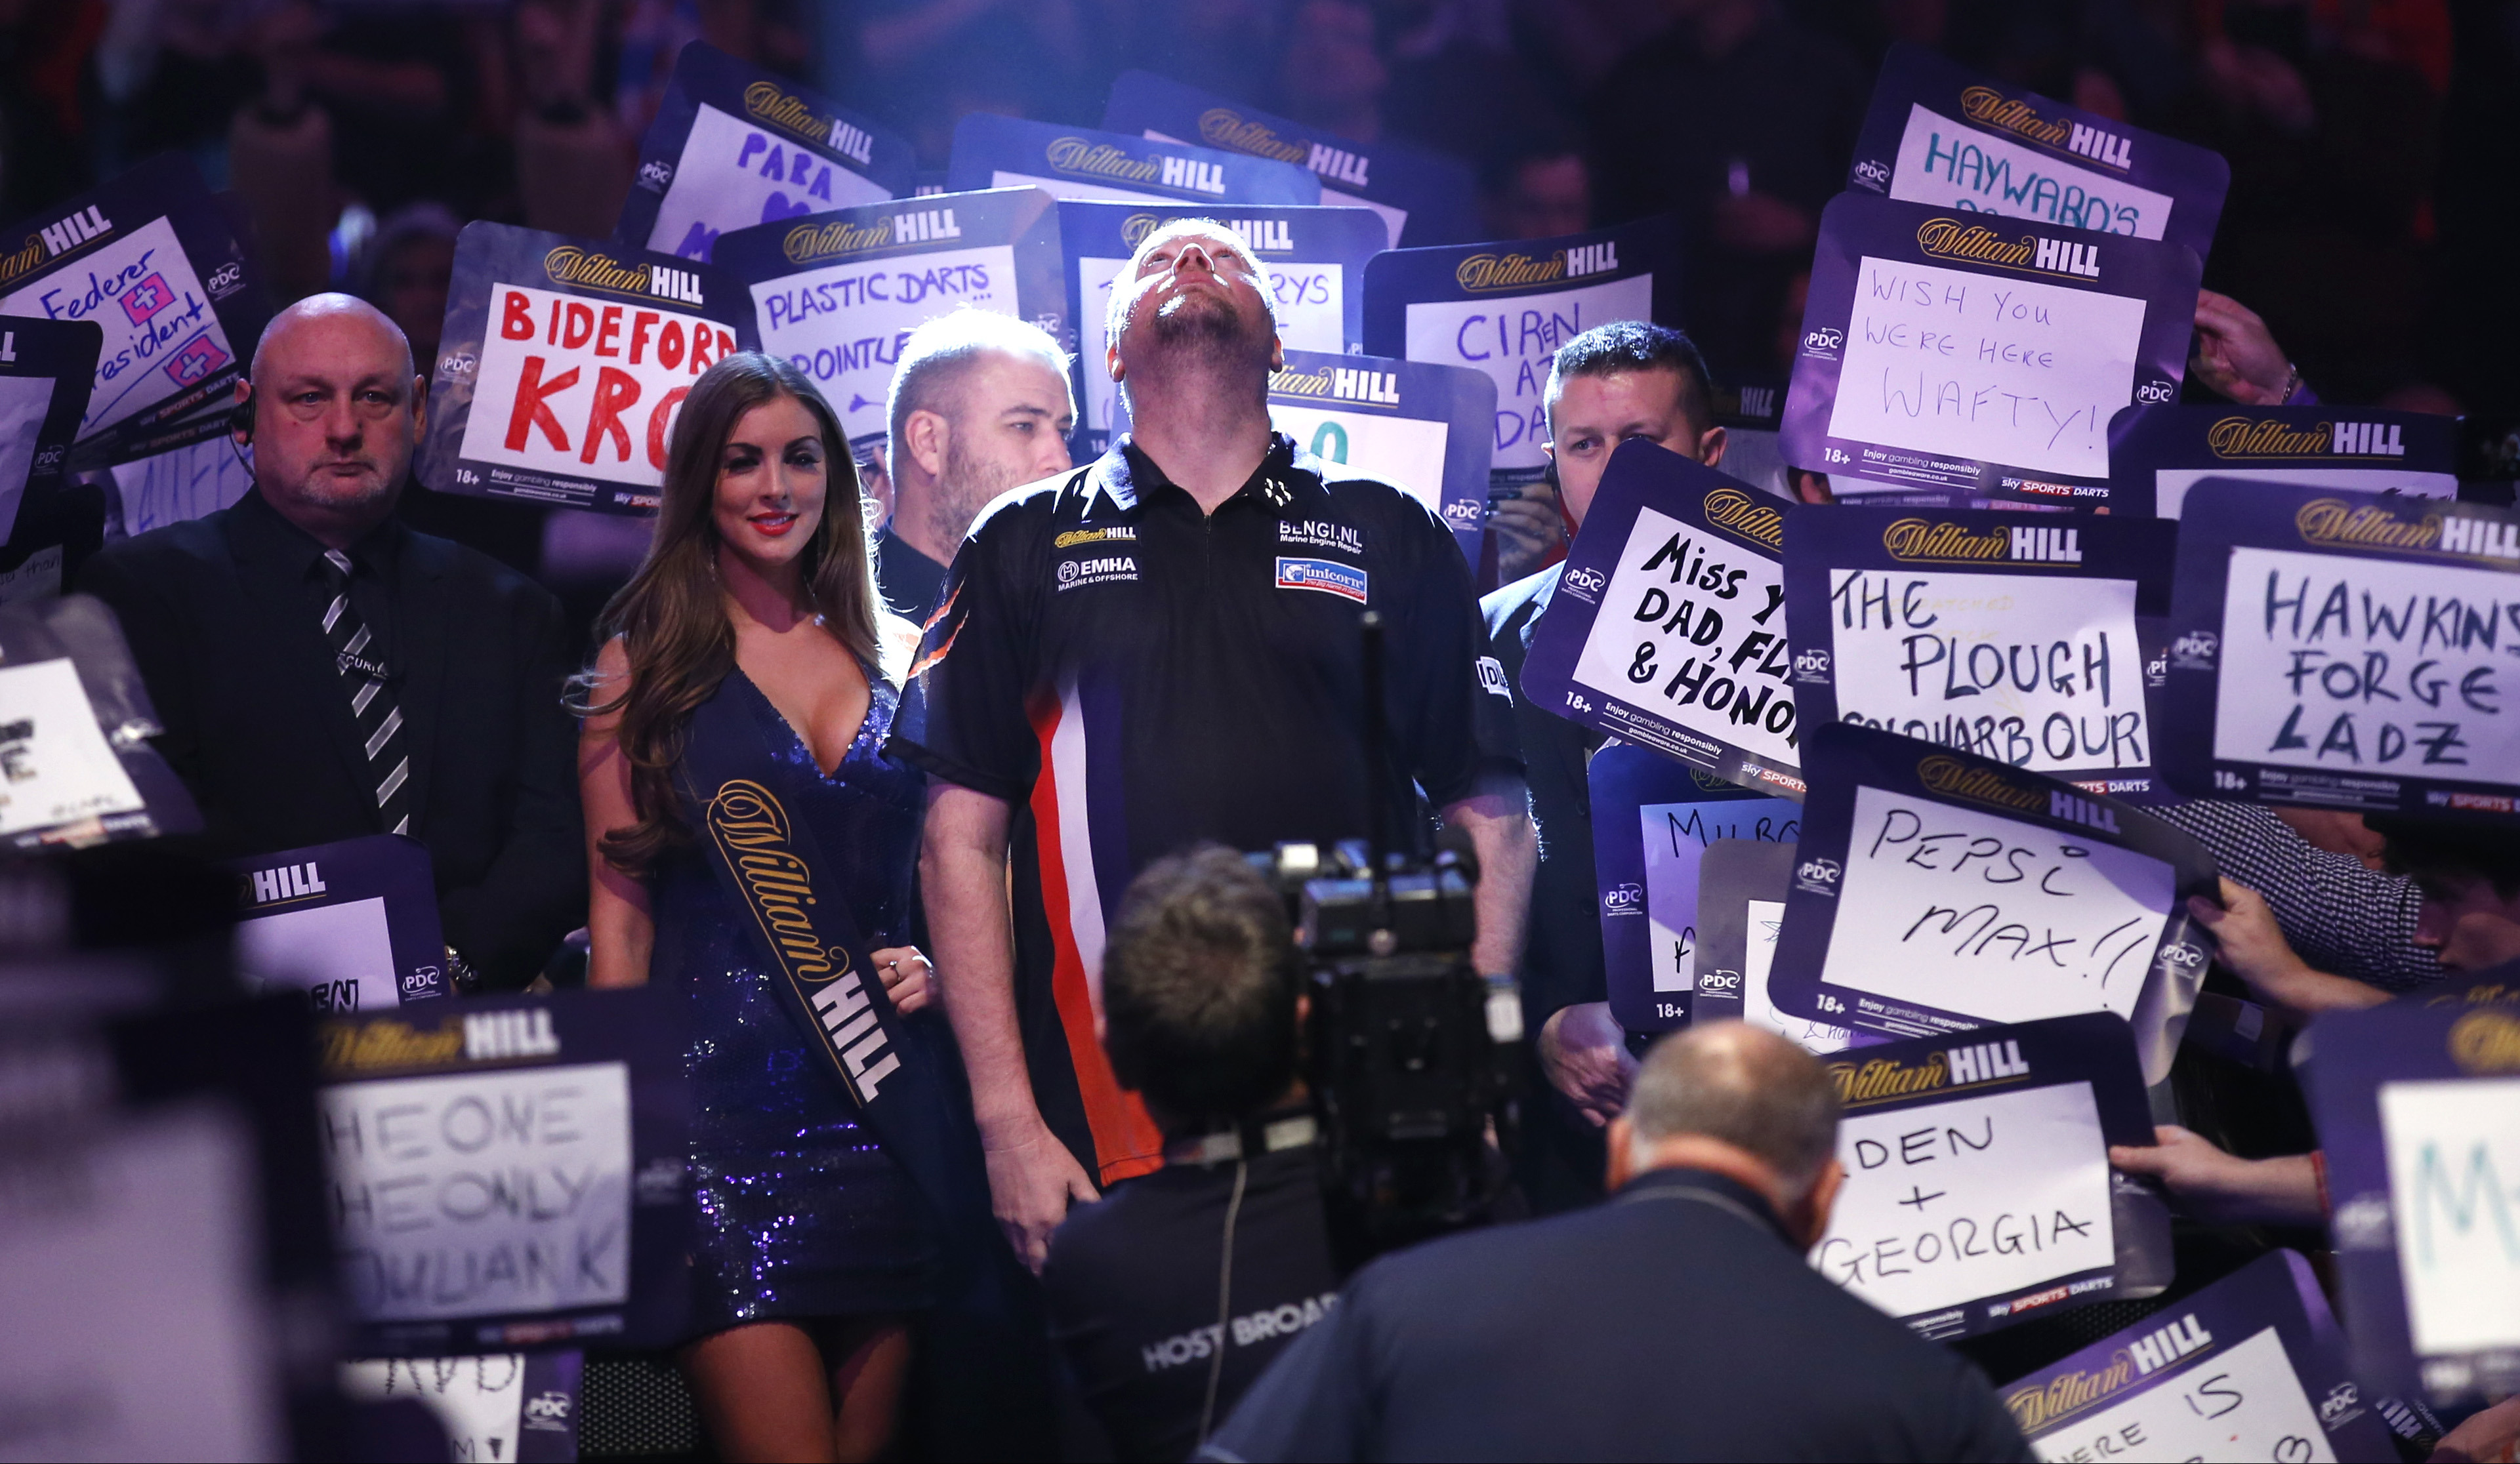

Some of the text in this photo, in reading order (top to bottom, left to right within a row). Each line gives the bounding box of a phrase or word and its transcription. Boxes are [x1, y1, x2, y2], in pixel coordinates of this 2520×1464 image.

[744, 81, 873, 165] William HILL
[1960, 86, 2132, 171] William HILL
[737, 132, 831, 202] PARA
[1046, 136, 1226, 195] William HILL
[1199, 108, 1369, 187] William HILL
[1856, 161, 1889, 183] PDC
[1924, 132, 2139, 237] HAYWARD'S
[41, 204, 112, 256] HILL
[783, 209, 960, 263] William HILL
[1231, 220, 1294, 250] HILL
[1917, 218, 2099, 277] William HILL
[39, 249, 155, 319] Federer
[208, 266, 240, 293] PDC
[544, 246, 703, 304] William HILL
[1456, 241, 1618, 293] William HILL
[766, 273, 888, 330] PLASTIC
[1873, 270, 1966, 314] WISH
[90, 292, 204, 392] resident
[1806, 330, 1840, 350] PDC
[1866, 317, 2054, 369] WERE HERE
[442, 354, 474, 374] PDC
[1334, 368, 1399, 403] HILL
[2139, 384, 2171, 402] PDC
[1884, 367, 2099, 451] WAFTY!
[36, 449, 62, 465] PDC
[1824, 447, 1851, 465] 18+
[2208, 417, 2405, 459] William HILL
[457, 468, 480, 485] 18+
[1863, 449, 1981, 476] Enjoy gambling responsibly
[1889, 468, 1949, 482] gambleaware.co.uk
[2001, 478, 2110, 498] sky SPORTS DARTS
[1447, 502, 1480, 520] PDC
[1704, 488, 1782, 546] Willi
[2296, 497, 2520, 559] William HILL
[1054, 527, 1136, 548] William HILL
[1279, 519, 1363, 548] BENGI.NL
[1280, 534, 1362, 555] Marine Engine Repair
[1884, 518, 2082, 563] William HILL
[1058, 578, 1087, 592] MARINE
[1095, 573, 1138, 582] OFFSHORE
[1081, 557, 1136, 575] EMHA
[1306, 567, 1361, 589] unicorn
[1567, 567, 1603, 592] PDC
[1831, 571, 1937, 630] THE
[1634, 587, 1723, 661] DAD,
[1627, 641, 1659, 684] &
[1796, 655, 1829, 672] PDC
[2176, 636, 2216, 657] PDC
[1901, 632, 2110, 707] PLOUGH
[2286, 650, 2500, 714] FORGE
[1565, 691, 1592, 713] 18+
[1605, 702, 1722, 755] Enjoy gambling responsibly
[1628, 727, 1687, 754] gambleaware.co.uk
[2269, 702, 2468, 765] LADZ
[1741, 760, 1761, 777] sky
[2108, 781, 2150, 794] DARTS
[1917, 755, 2120, 834] William HILL
[253, 861, 326, 903] HILL
[1800, 861, 1839, 884] PDC
[1607, 888, 1642, 905] PDC
[707, 779, 901, 1103] William HILL
[2161, 945, 2200, 967] PDC
[403, 971, 439, 990] PDC
[1702, 974, 1739, 989] PDC
[1657, 1003, 1684, 1018] 18+
[1817, 994, 1846, 1014] 18+
[1859, 998, 1884, 1012] Enjoy
[1886, 1006, 1930, 1023] gambling
[1930, 1017, 1979, 1030] responsi
[465, 1009, 560, 1061] HILL
[1948, 1040, 2030, 1084] HILL
[442, 1086, 583, 1152] ONE
[437, 1166, 597, 1222] ONLY
[1819, 1211, 2092, 1288] GEORGIA
[2012, 1286, 2069, 1314] SPORTS
[2069, 1276, 2114, 1296] DARTS
[1142, 1322, 1224, 1373] HOST
[2004, 1312, 2213, 1431] William HILL
[2184, 1373, 2243, 1420] IS
[2320, 1385, 2359, 1421] PDC
